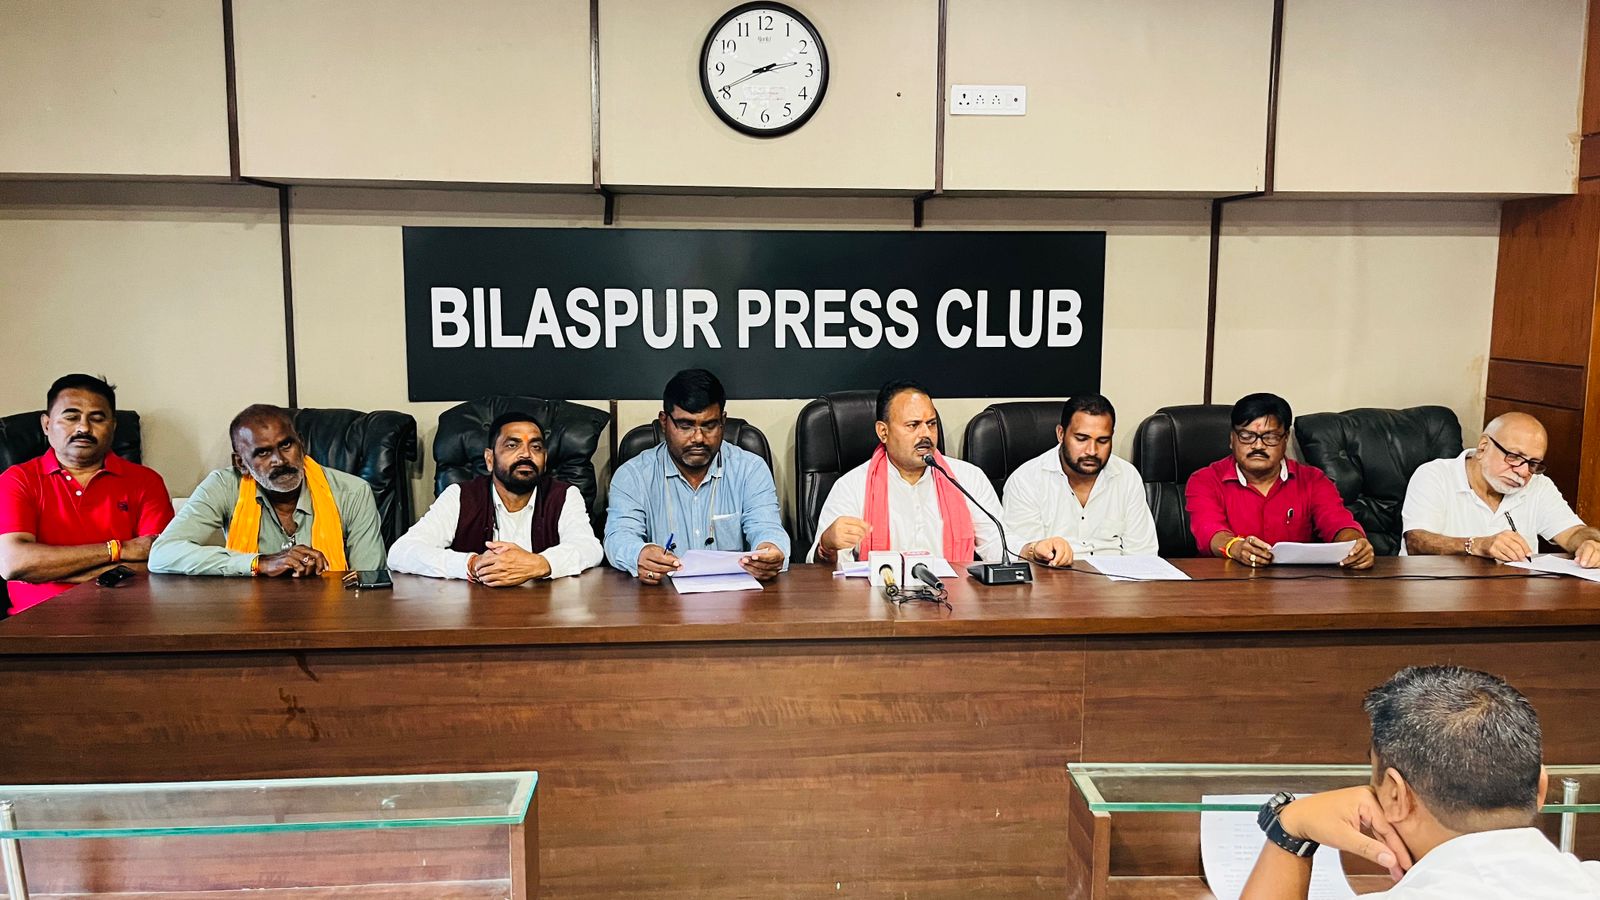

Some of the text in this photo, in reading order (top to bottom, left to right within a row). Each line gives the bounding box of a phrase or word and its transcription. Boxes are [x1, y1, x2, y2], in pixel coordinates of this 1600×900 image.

[738, 22, 749, 37] 11
[758, 15, 774, 31] 12
[785, 22, 790, 37] 1
[721, 39, 737, 54] 10
[798, 39, 808, 55] 2
[715, 61, 725, 77] 9
[804, 62, 814, 78] 3
[722, 84, 732, 100] 8
[797, 86, 808, 100] 4
[738, 102, 748, 117] 7
[760, 109, 770, 123] 6
[783, 102, 792, 117] 5
[430, 286, 1083, 350] BILASPUR PRESS CLUB
